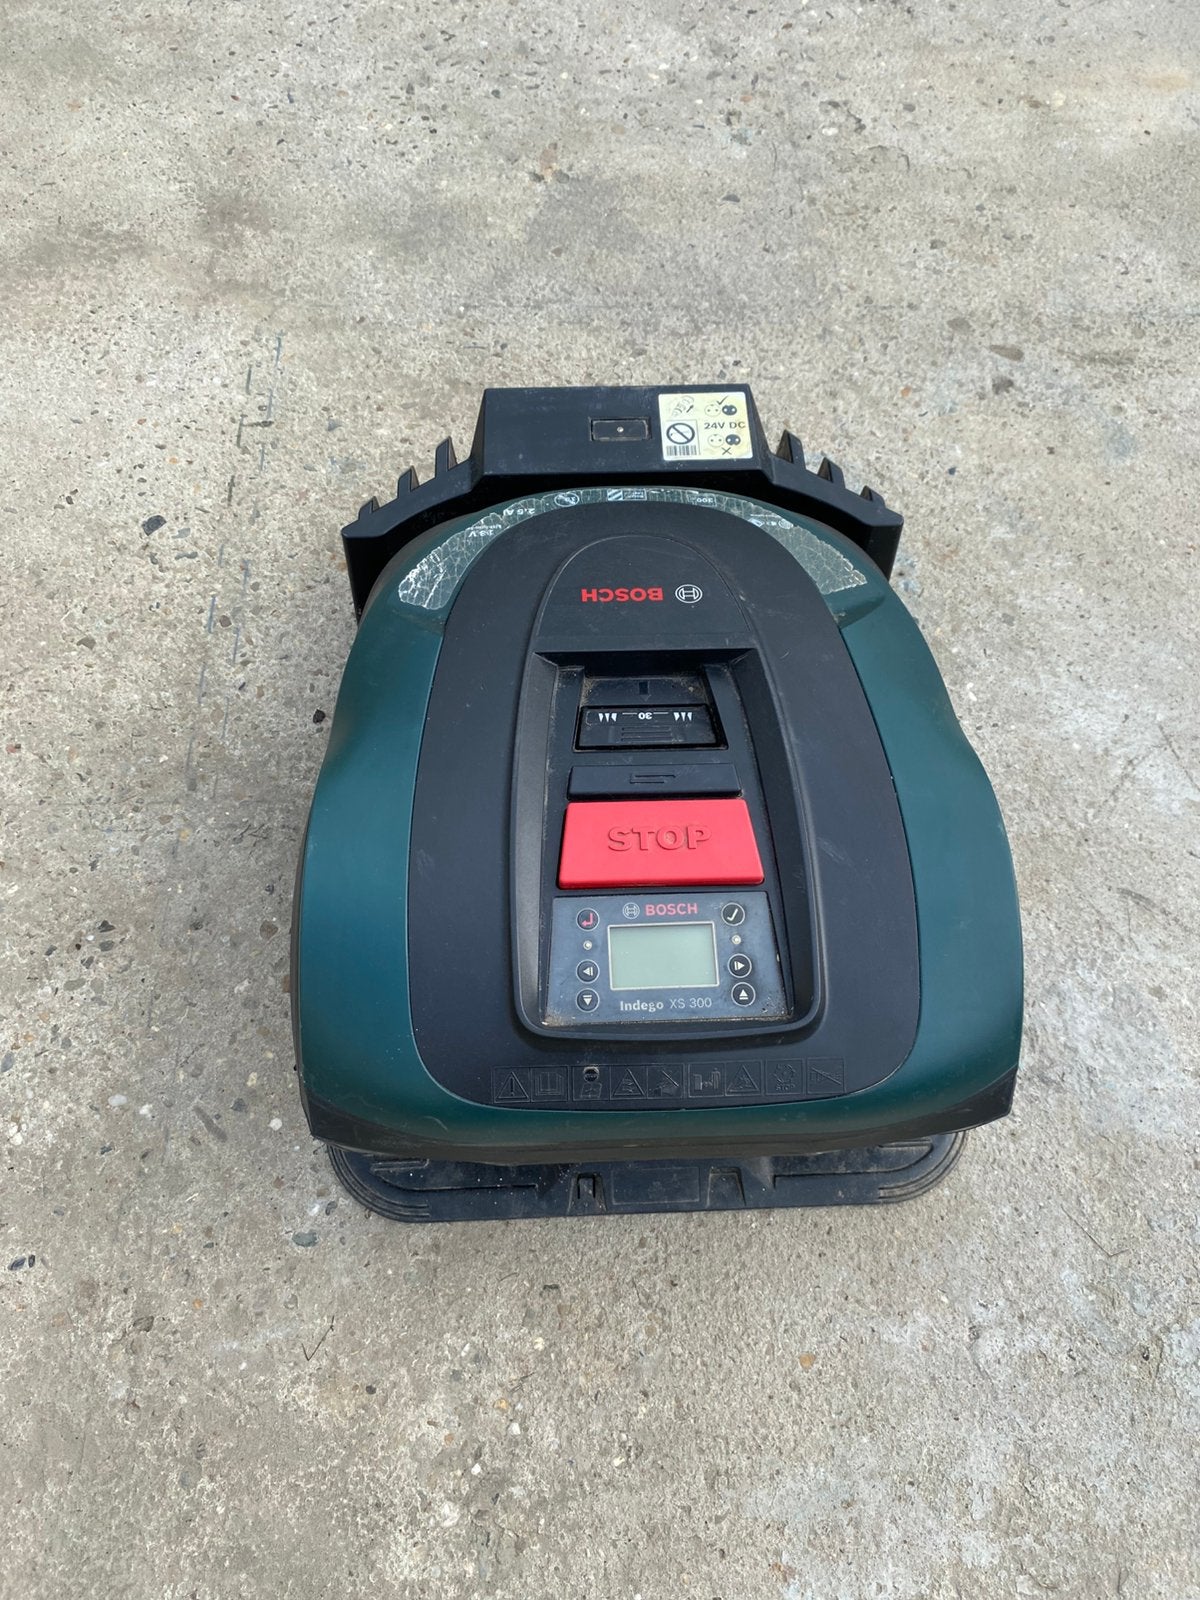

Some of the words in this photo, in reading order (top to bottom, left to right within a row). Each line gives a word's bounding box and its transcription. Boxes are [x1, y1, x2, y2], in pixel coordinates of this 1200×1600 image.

[704, 421, 725, 430] 24V
[729, 421, 746, 429] DC
[581, 587, 664, 602] BOSCH
[638, 712, 653, 720] 30
[607, 824, 713, 852] STOP
[645, 903, 698, 916] BOSCH
[619, 1000, 664, 1013] Indego
[669, 999, 685, 1009] XS
[689, 998, 712, 1009] 300
